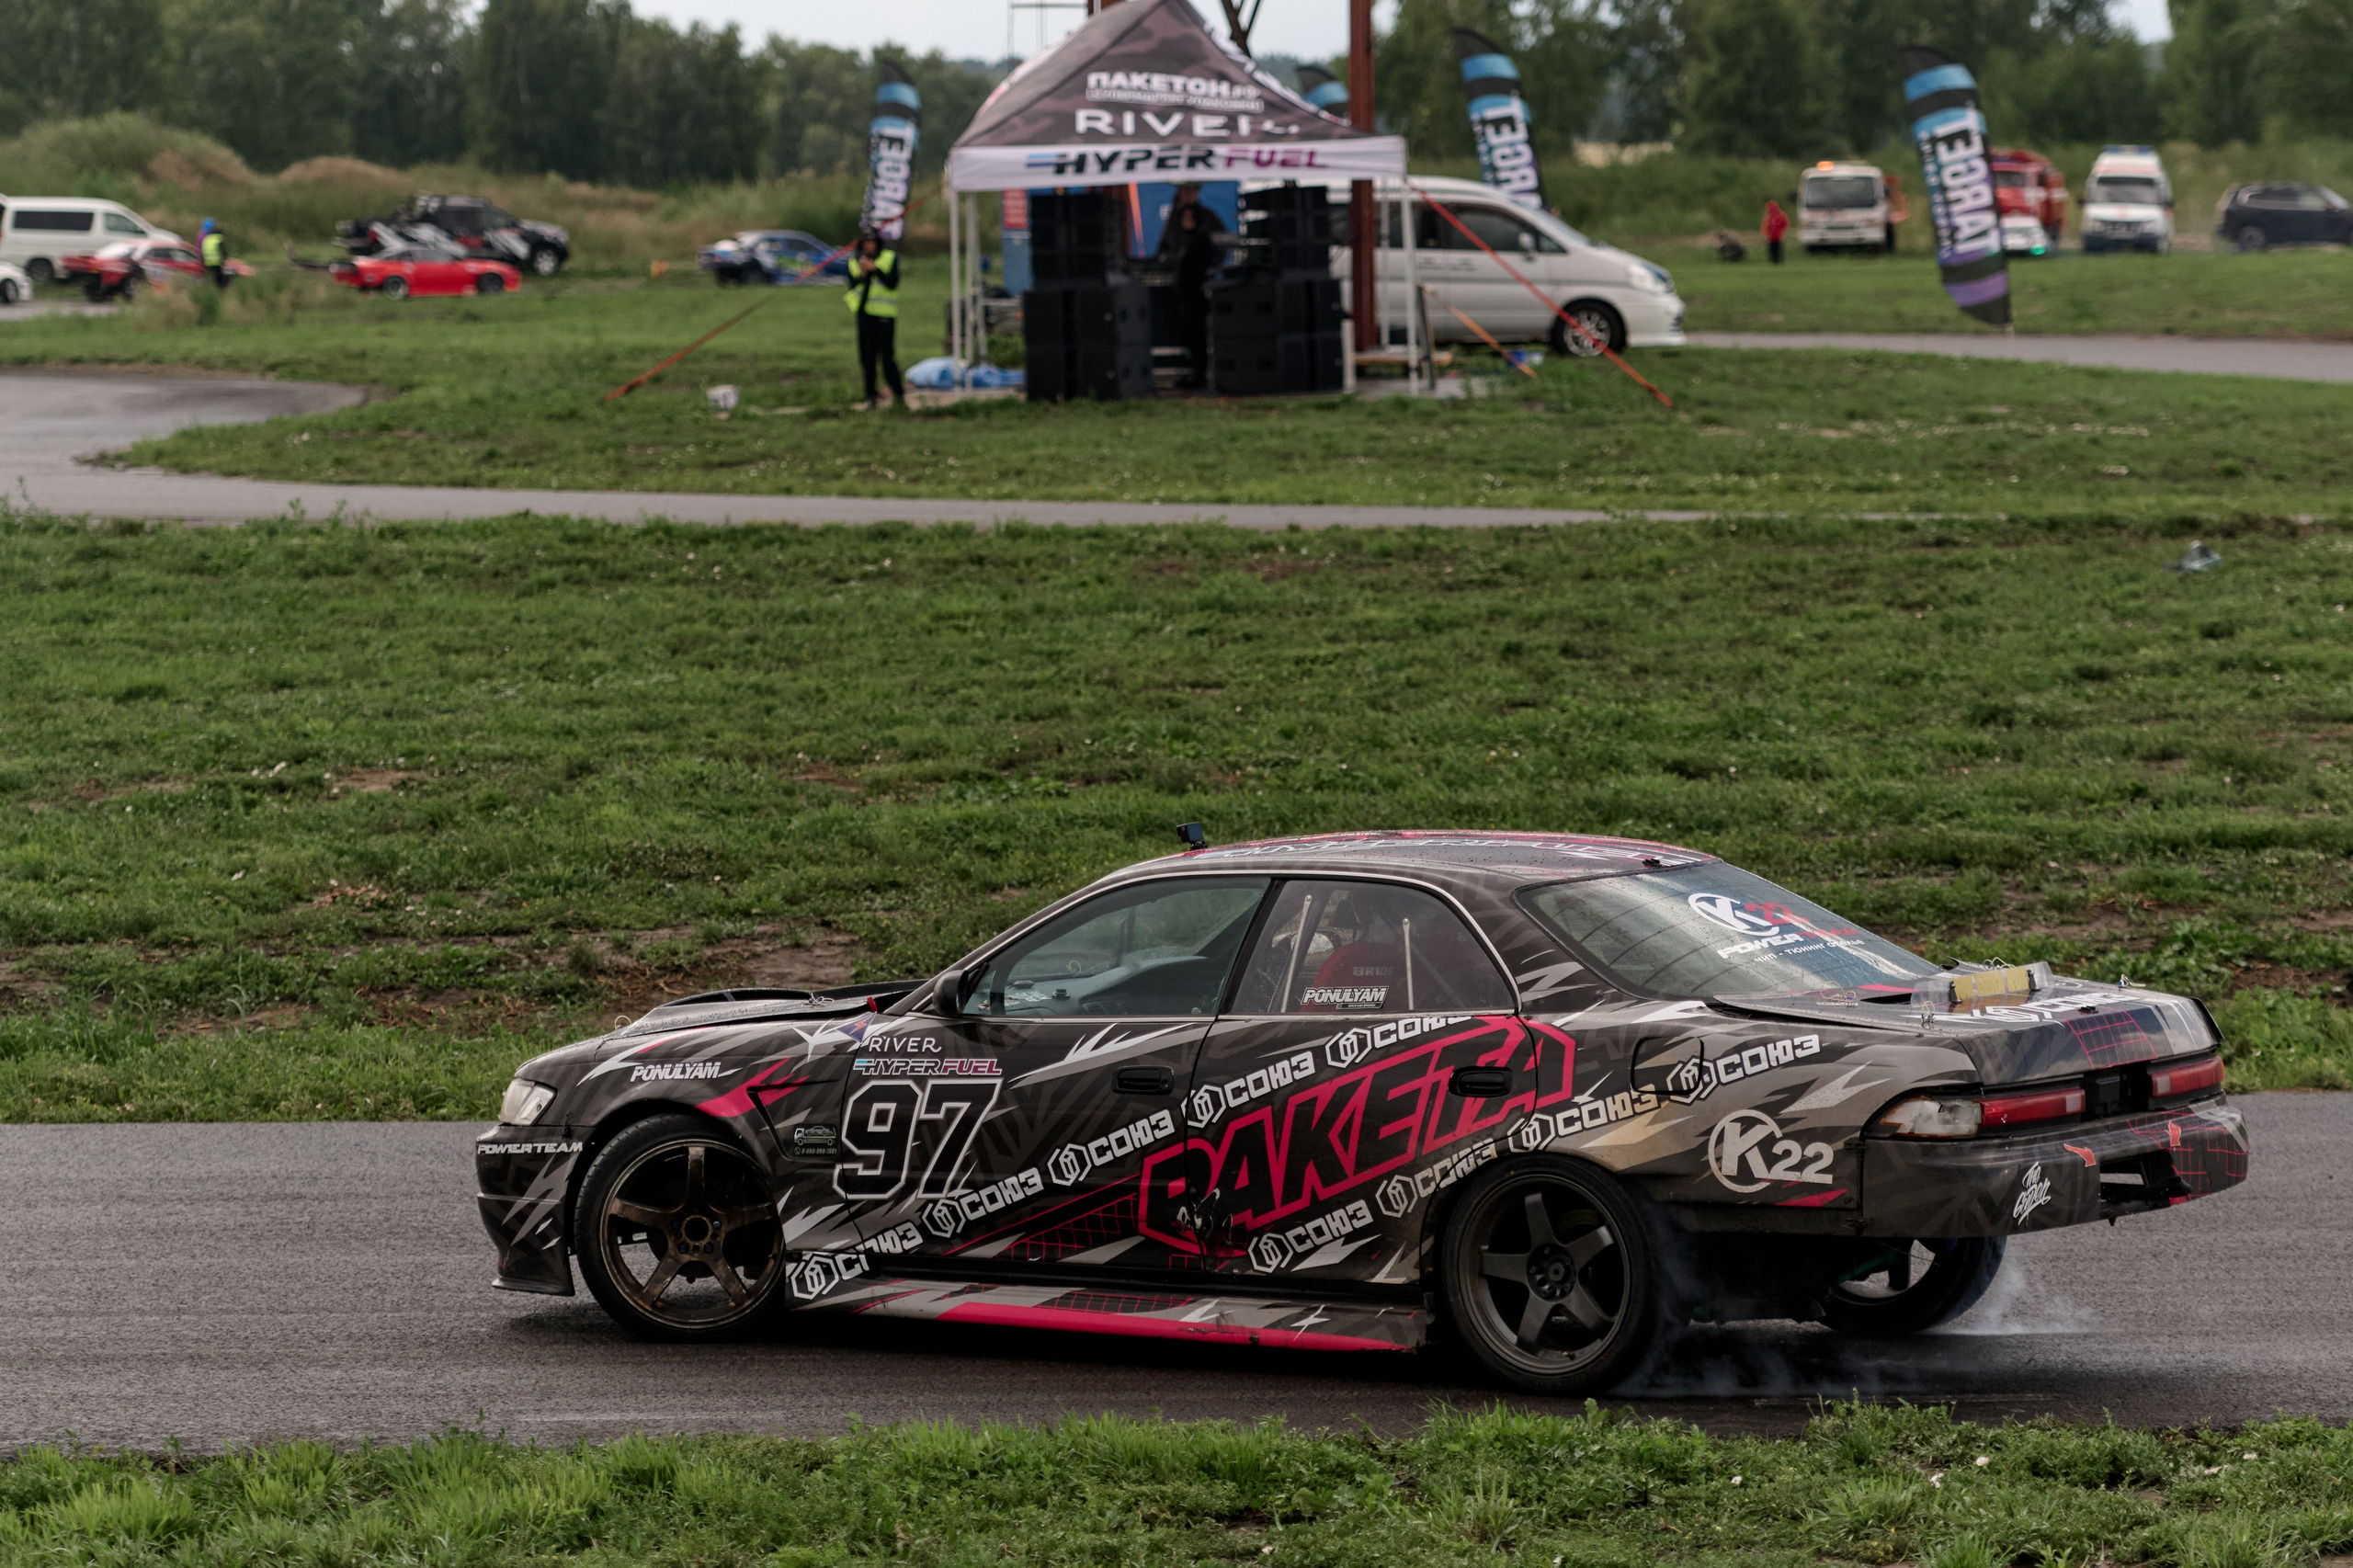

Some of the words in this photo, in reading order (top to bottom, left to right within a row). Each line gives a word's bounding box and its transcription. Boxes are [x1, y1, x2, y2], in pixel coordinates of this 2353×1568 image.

[1302, 986, 1388, 1004] PONULYAM
[630, 1062, 722, 1083] PONULYAM
[869, 1037, 942, 1052] RIVER
[832, 1079, 1004, 1199] 97
[961, 1167, 1044, 1221] СОЮЗ
[1086, 1109, 1175, 1165] СОЮЗ
[1223, 1051, 1315, 1108] СОЮЗ
[1287, 1199, 1373, 1254] СОЮЗ
[1556, 1084, 1658, 1136] СОЮЗ
[1717, 1034, 1821, 1084] СОЮЗ
[1711, 1111, 1833, 1191] K22
